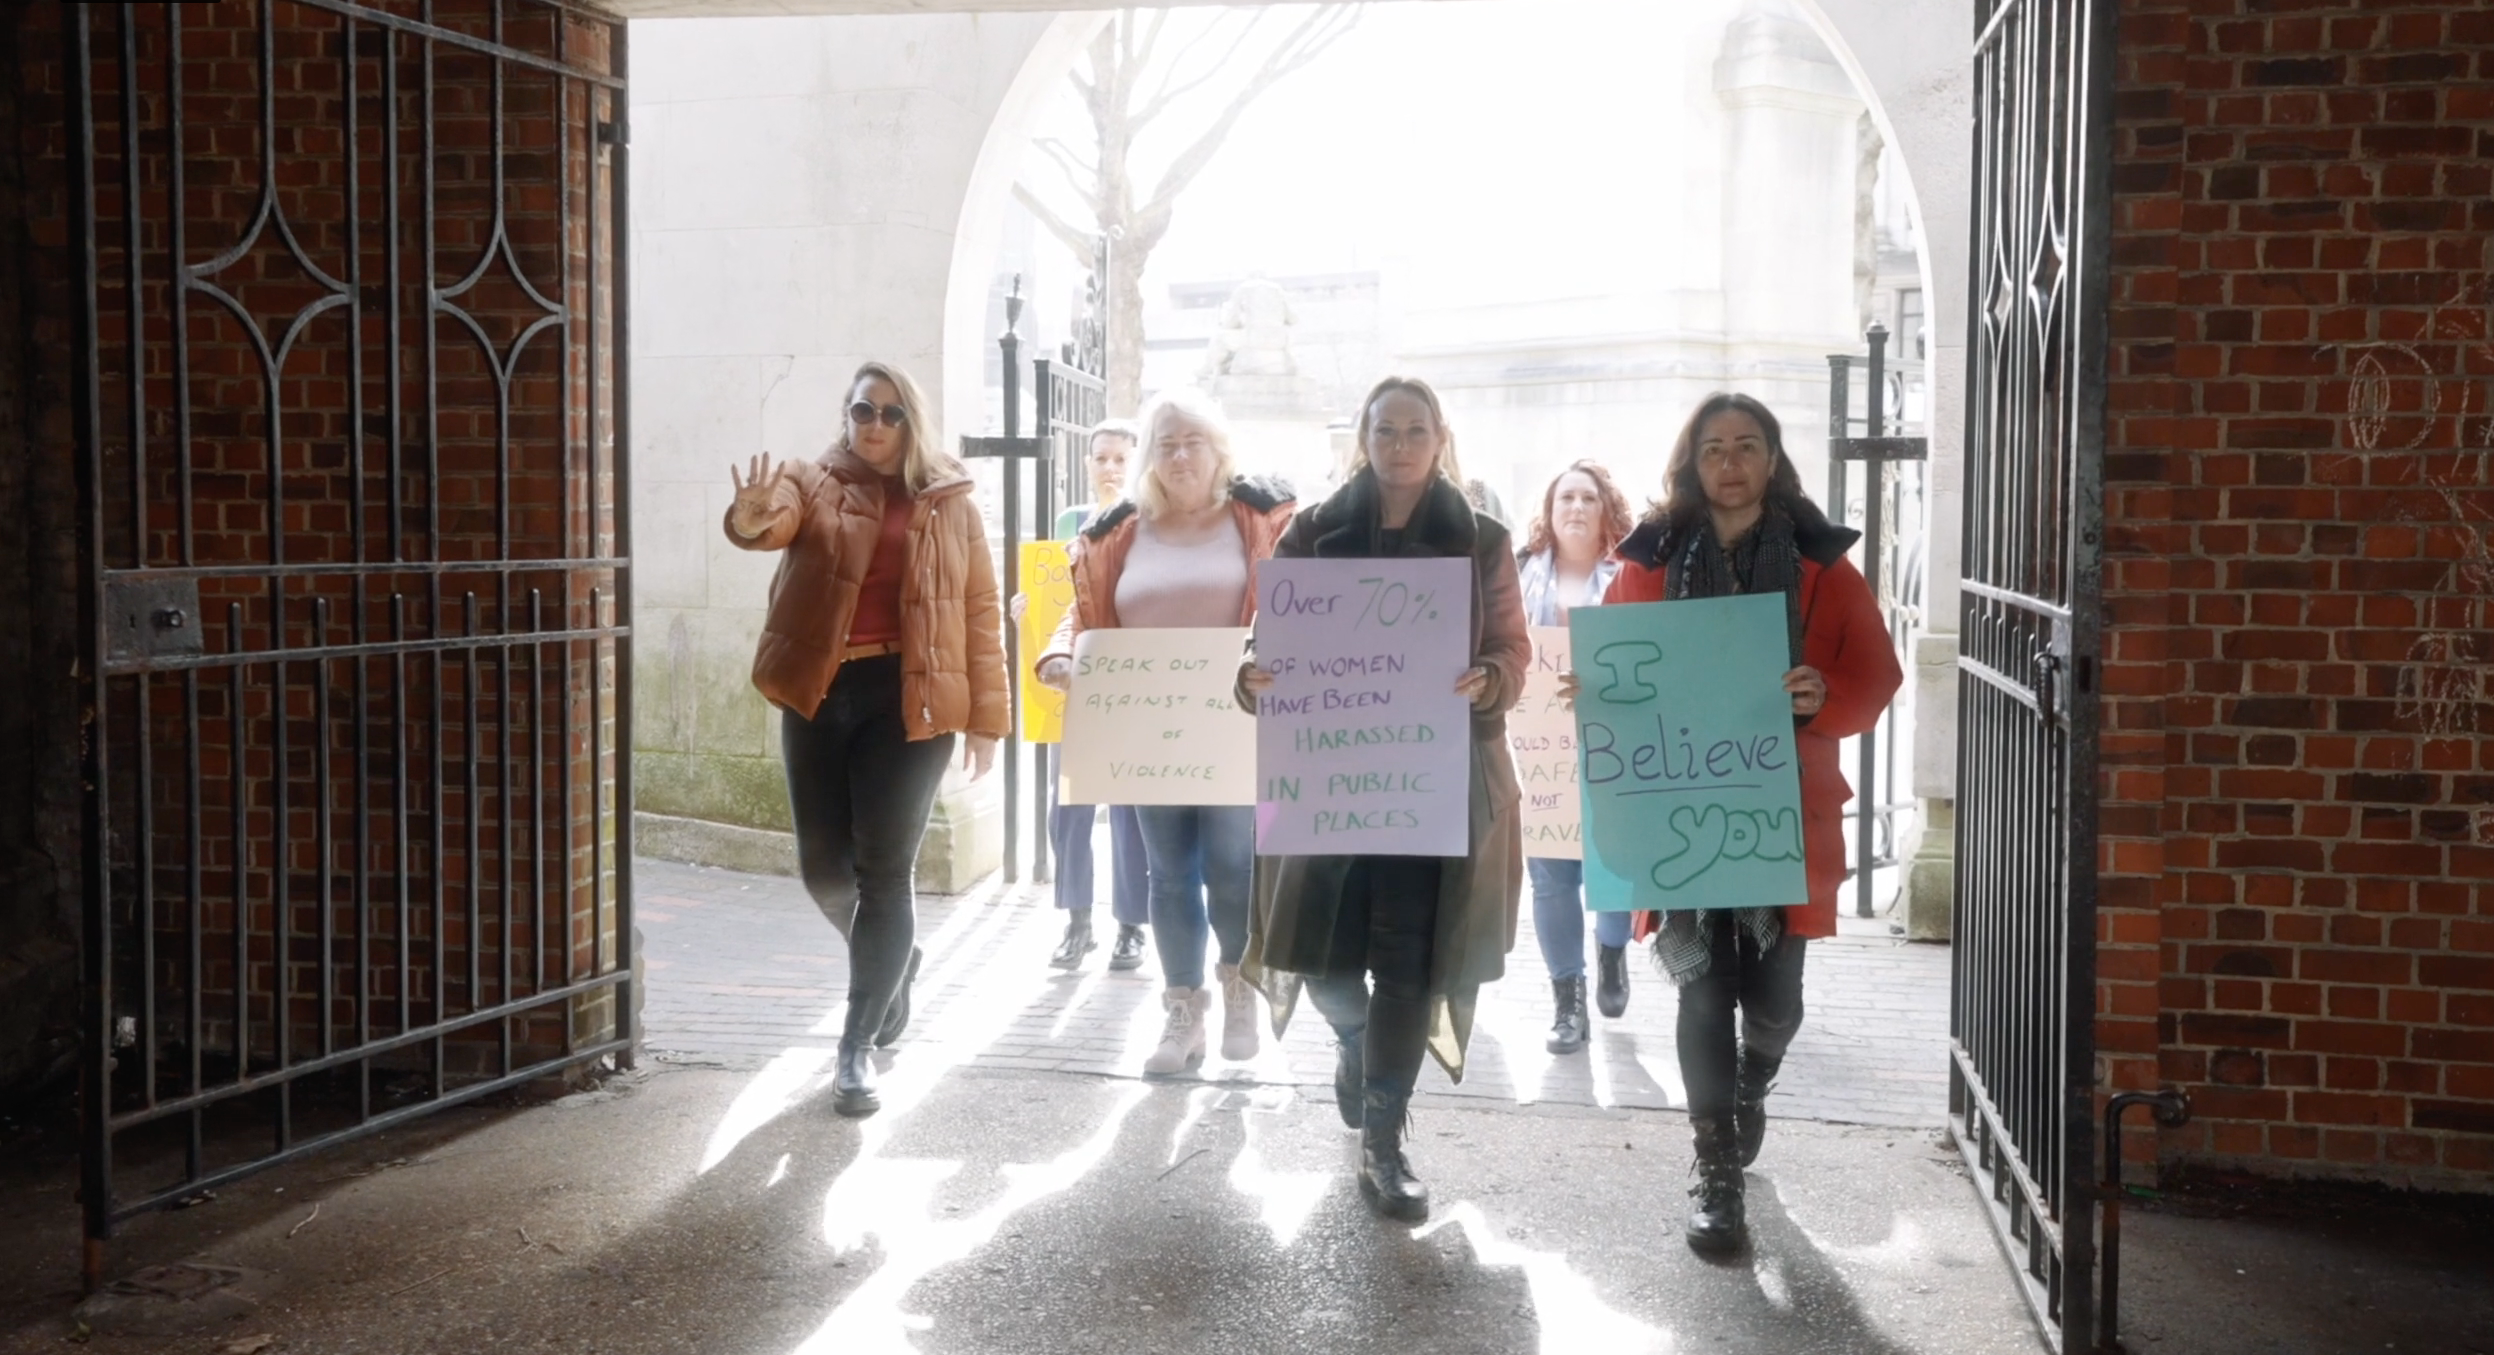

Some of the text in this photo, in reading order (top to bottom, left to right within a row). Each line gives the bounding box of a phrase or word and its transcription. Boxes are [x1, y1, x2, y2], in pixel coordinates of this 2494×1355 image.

[1271, 577, 1437, 632] Over 70%
[1078, 655, 1209, 676] SPEAK OUT
[1270, 653, 1405, 677] OF WOMEN
[1594, 640, 1662, 704] I
[1086, 693, 1187, 714] AGAINST
[1205, 698, 1234, 710] ALL
[1260, 688, 1391, 716] HAVE BEEN
[1162, 729, 1184, 739] OF
[1295, 723, 1435, 753] HARASSED
[1583, 714, 1787, 783] Believe
[1110, 762, 1215, 780] VIOLENCE
[1268, 771, 1436, 801] IN PUBLIC
[1531, 793, 1563, 808] NOT
[1314, 809, 1419, 835] PLACES
